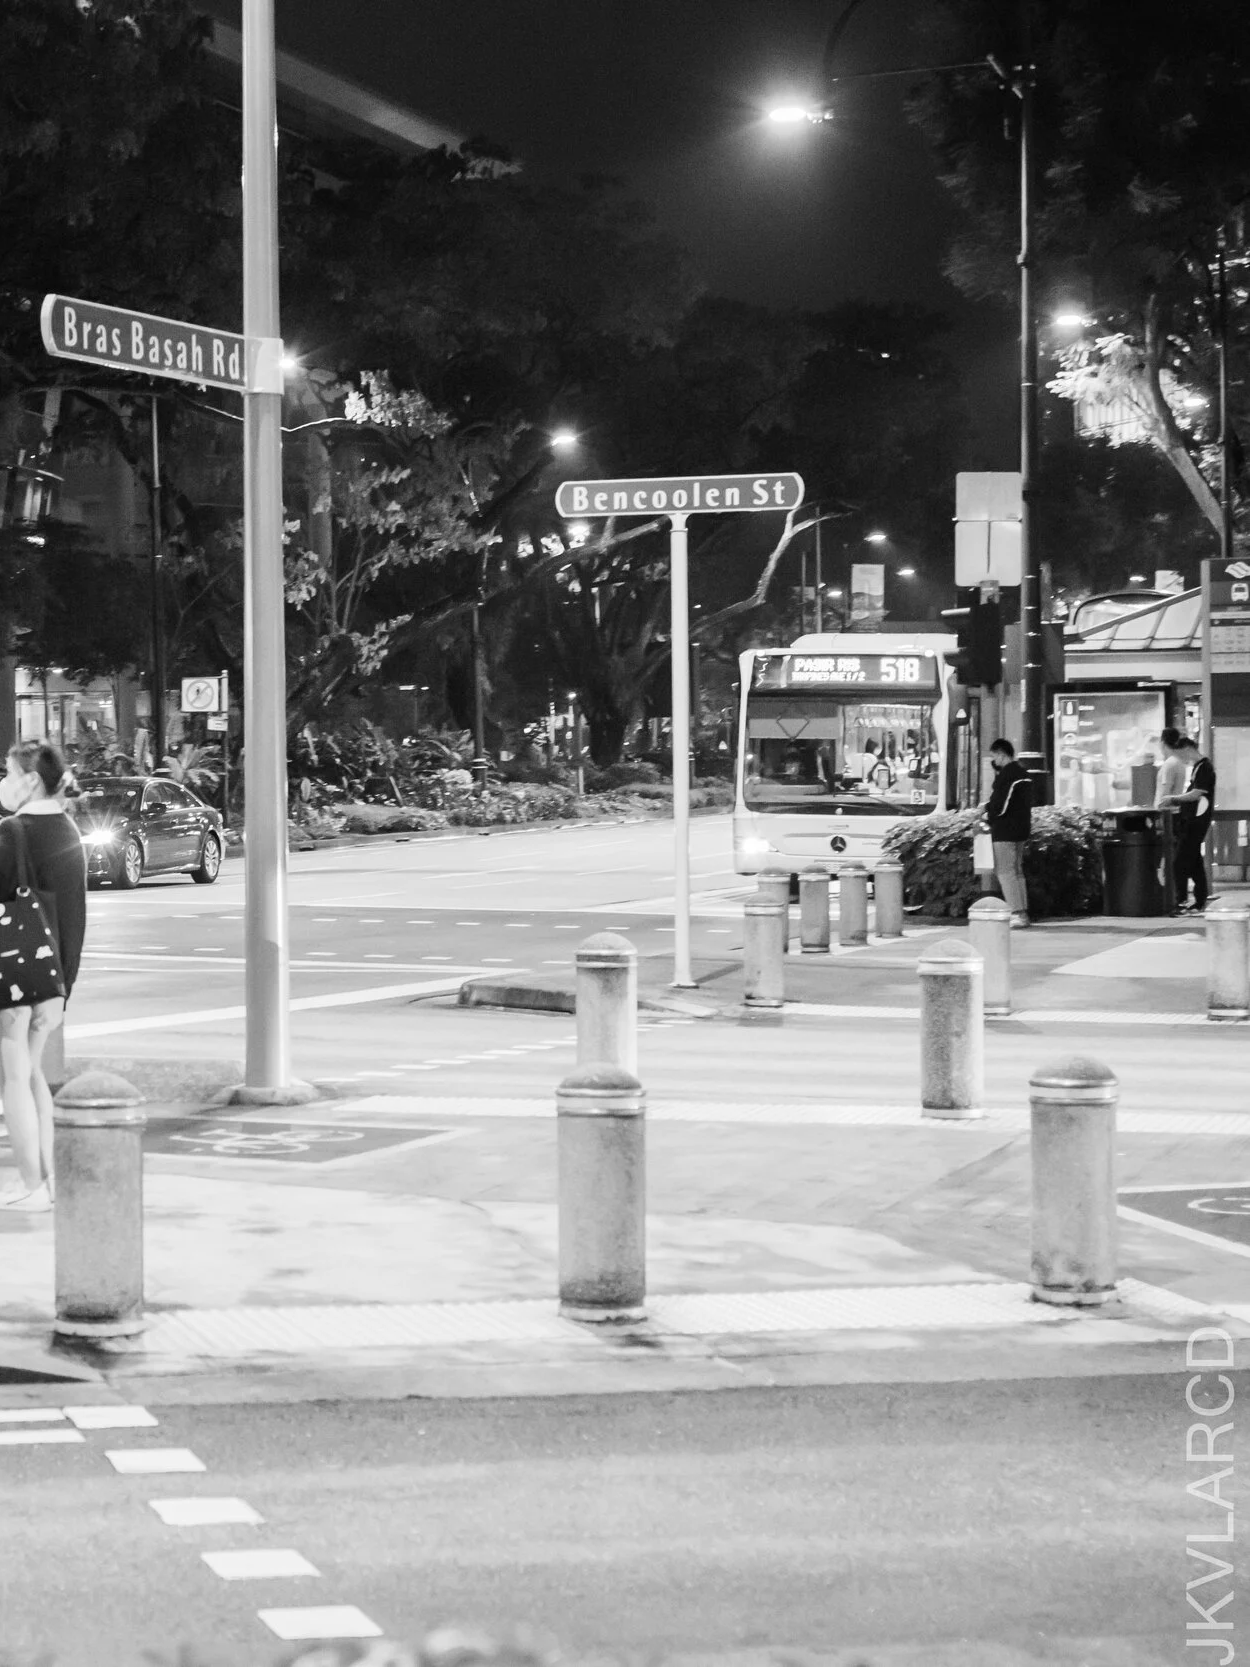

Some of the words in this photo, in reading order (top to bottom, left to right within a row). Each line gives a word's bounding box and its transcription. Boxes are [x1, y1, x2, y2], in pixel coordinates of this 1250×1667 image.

[63, 306, 122, 356] Bras
[131, 321, 204, 372] Basah
[212, 338, 241, 380] Rd
[572, 482, 741, 511] Bencoolen
[752, 479, 786, 505] St
[880, 657, 920, 683] 518
